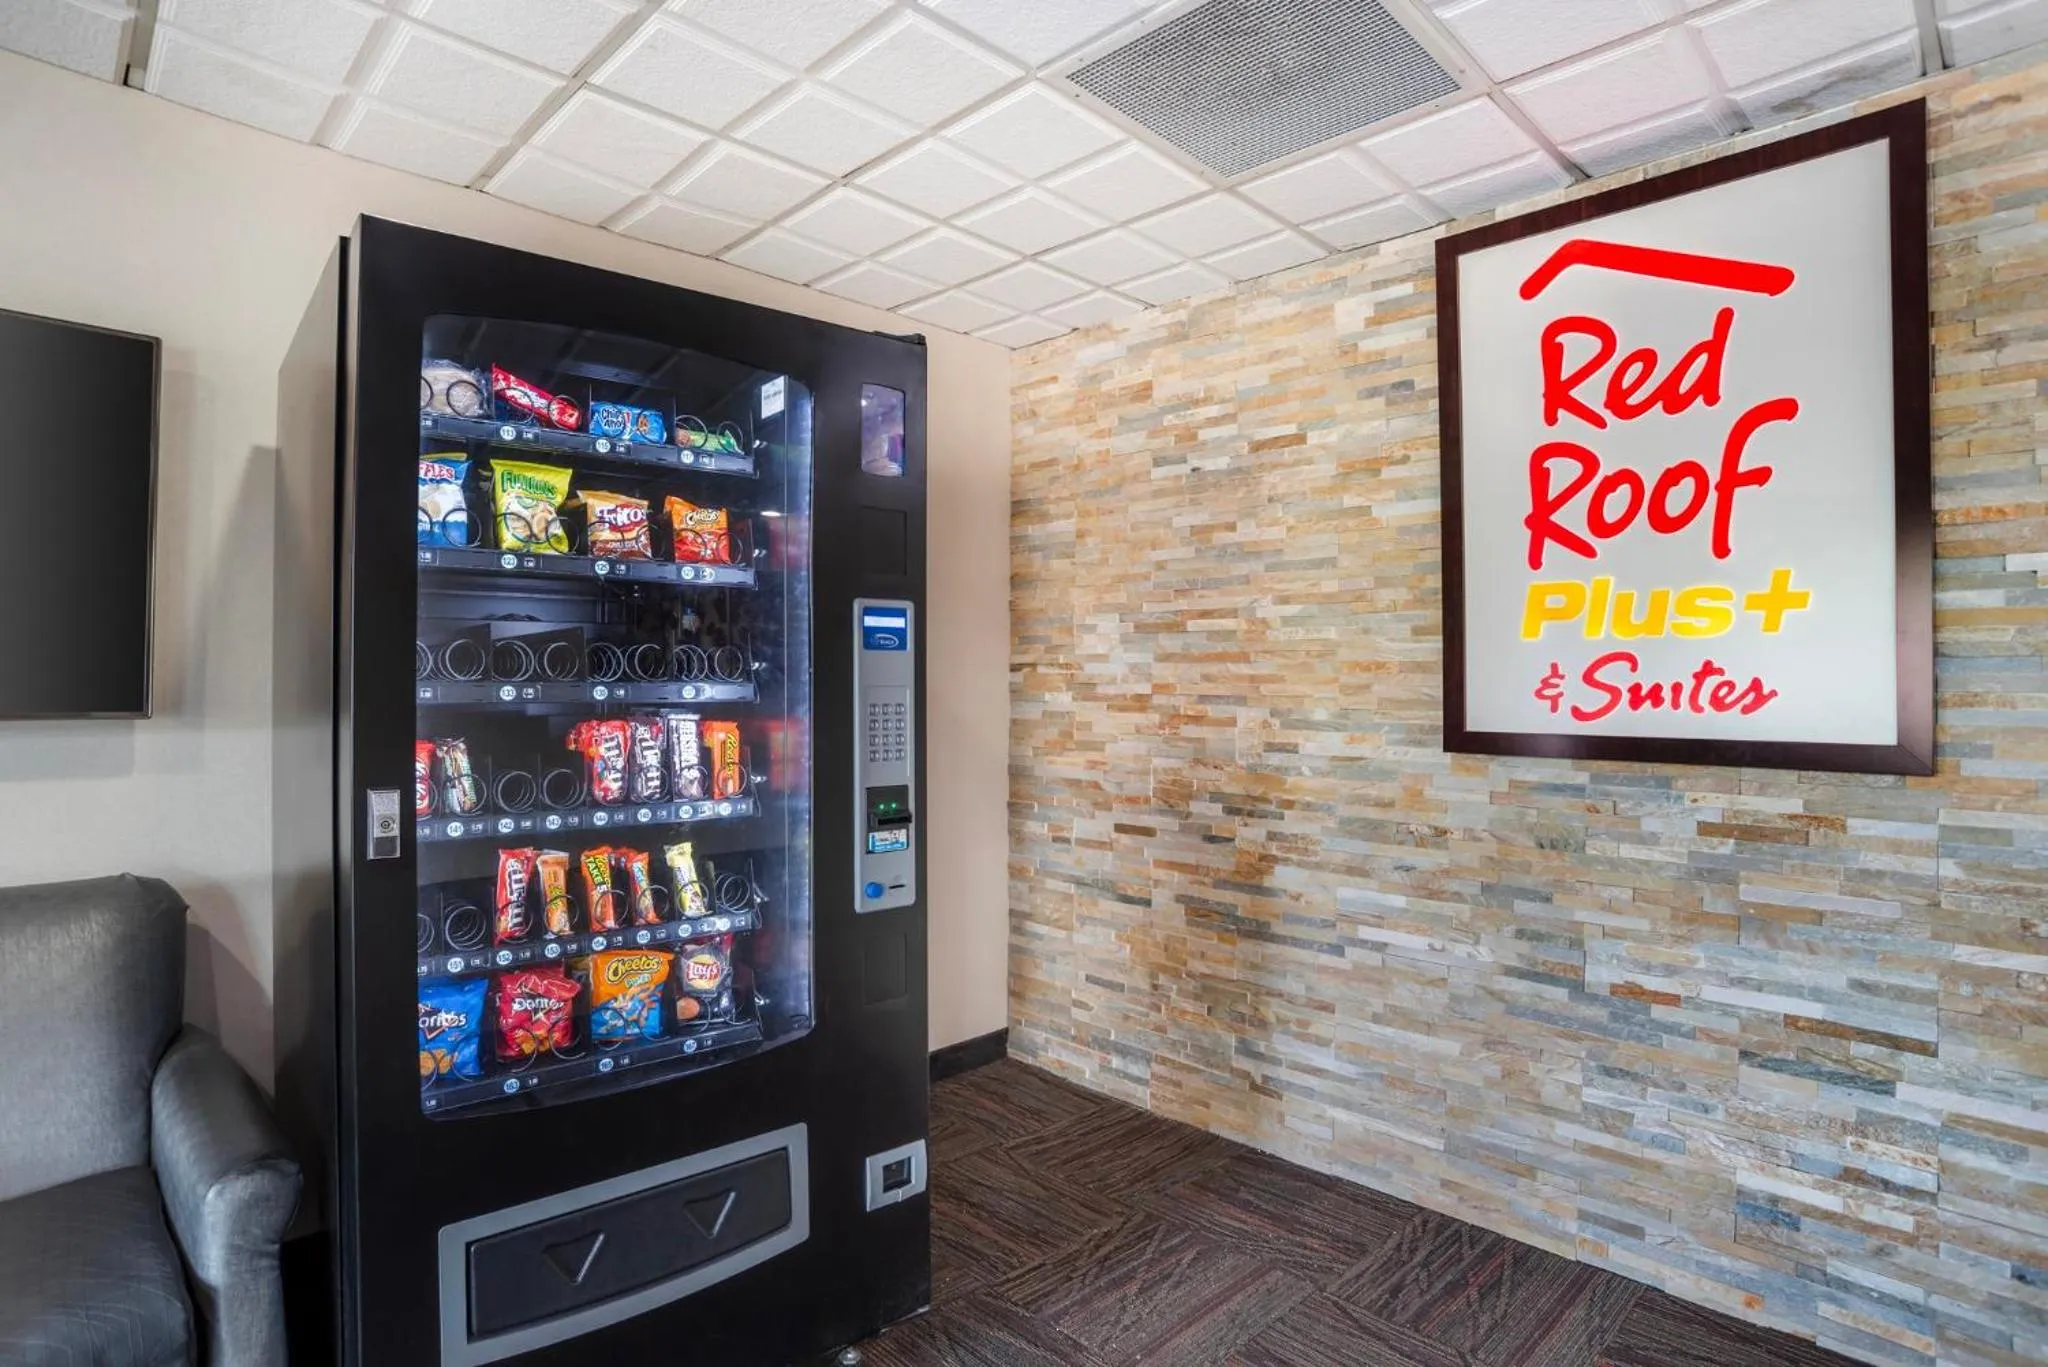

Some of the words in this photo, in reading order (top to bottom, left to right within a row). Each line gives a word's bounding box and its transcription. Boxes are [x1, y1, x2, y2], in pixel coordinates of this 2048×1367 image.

[1541, 307, 1734, 430] Red
[1524, 398, 1799, 570] Roof
[596, 506, 647, 528] Fritos
[1534, 662, 1567, 714] &
[1571, 650, 1778, 721] Suites
[586, 857, 604, 885] TAKE
[598, 884, 608, 893] 5
[607, 956, 661, 983] Cheetos
[687, 962, 720, 980] Lay's
[512, 998, 563, 1011] Doritos
